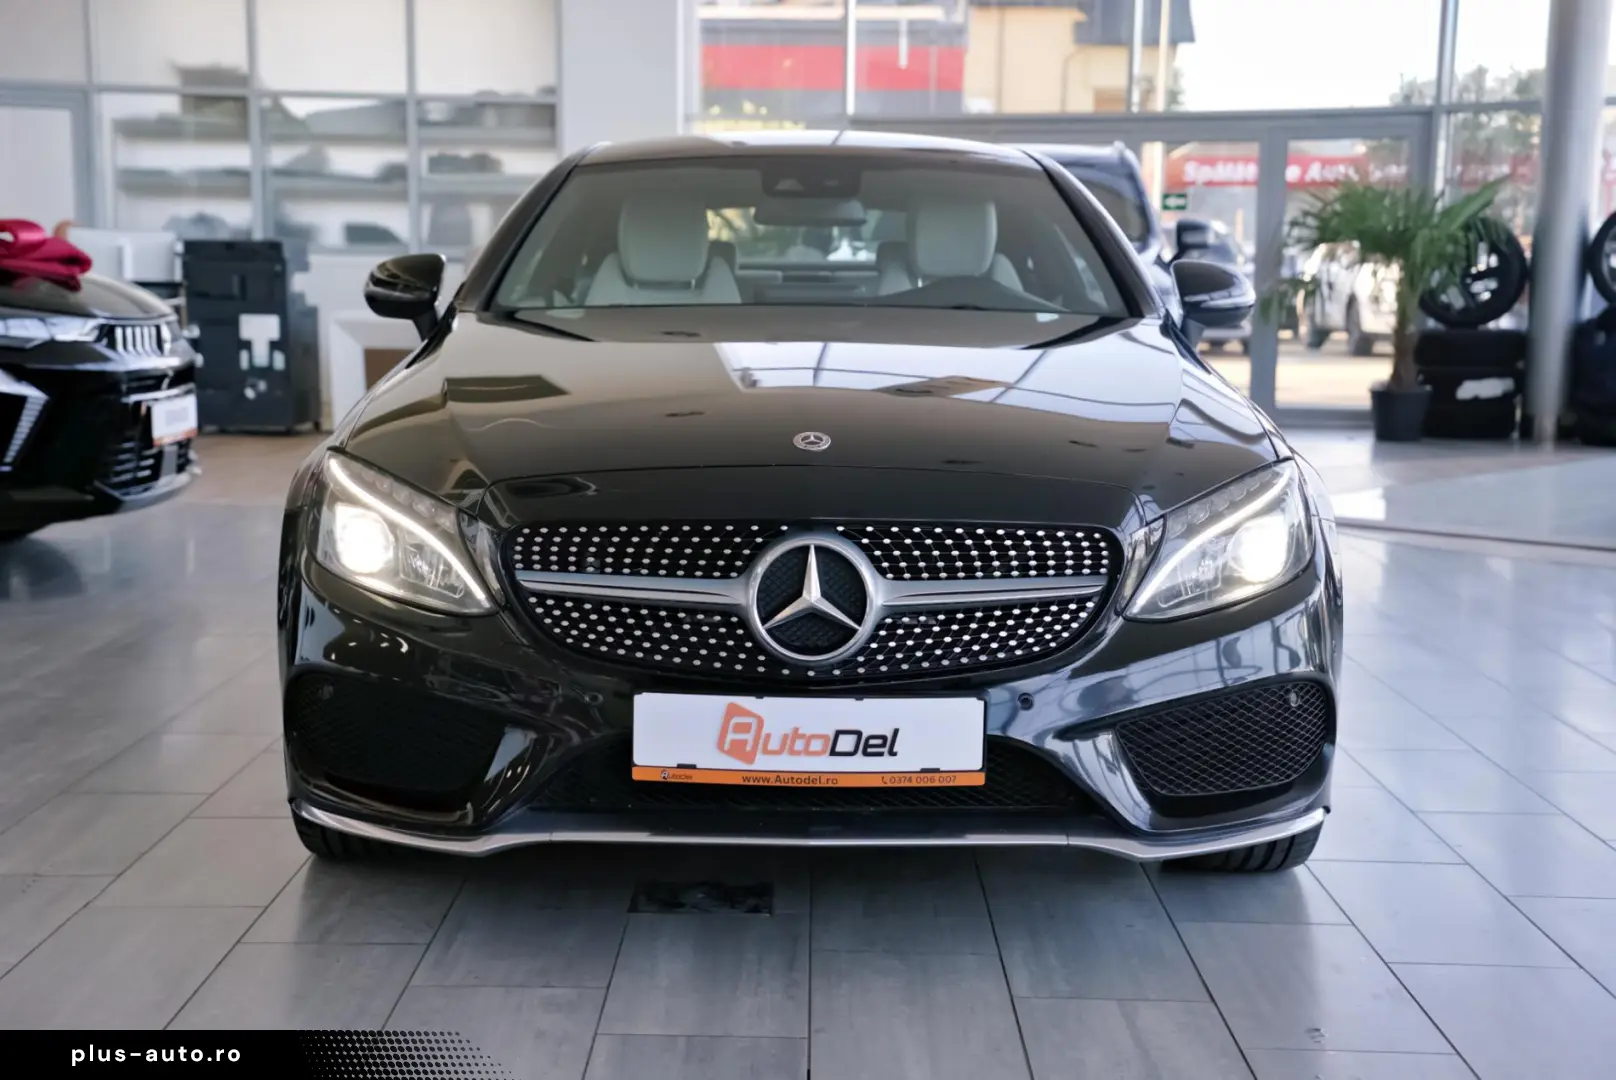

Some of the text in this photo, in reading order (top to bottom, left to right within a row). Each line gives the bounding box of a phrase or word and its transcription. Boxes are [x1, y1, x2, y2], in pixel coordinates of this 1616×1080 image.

[718, 707, 900, 762] AutoDel
[742, 774, 838, 786] www.Autodel.ro
[889, 776, 912, 785] 0374
[915, 776, 936, 785] 006
[938, 776, 957, 785] 007
